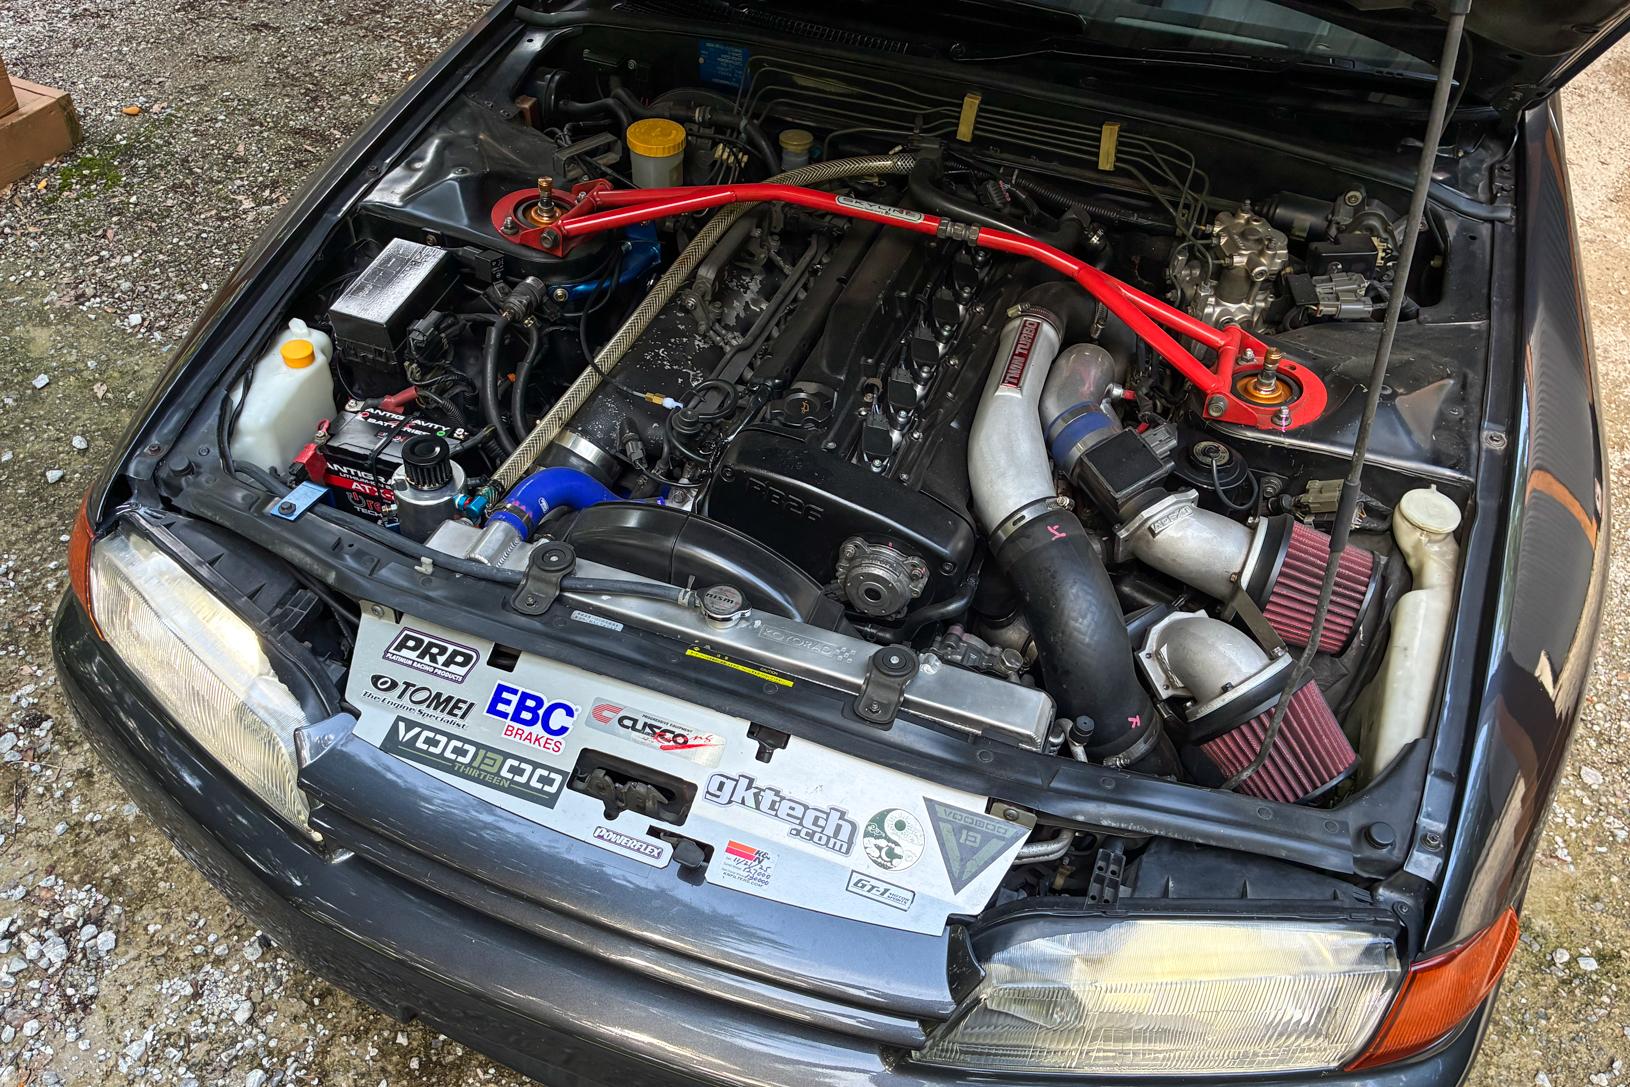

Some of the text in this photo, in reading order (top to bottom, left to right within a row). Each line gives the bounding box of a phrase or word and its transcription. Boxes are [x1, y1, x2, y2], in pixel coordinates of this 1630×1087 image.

[1004, 321, 1038, 384] TWIN TURBO
[365, 408, 451, 431] ANTIGAVITY
[393, 633, 474, 668] PRP
[386, 653, 463, 681] PLATINUM RACING PRODUCTS
[362, 691, 469, 729] The Engine Specialist
[397, 681, 476, 720] TOMEI
[486, 683, 575, 736] EBC
[504, 725, 563, 753] BRAKES
[617, 715, 689, 745] CUSCO
[453, 763, 511, 788] THIRTEEN
[705, 774, 857, 844] gktech
[594, 827, 661, 857] POWERFLEX
[790, 827, 852, 855] .com
[960, 828, 981, 848] 13
[853, 878, 891, 896] GT-1
